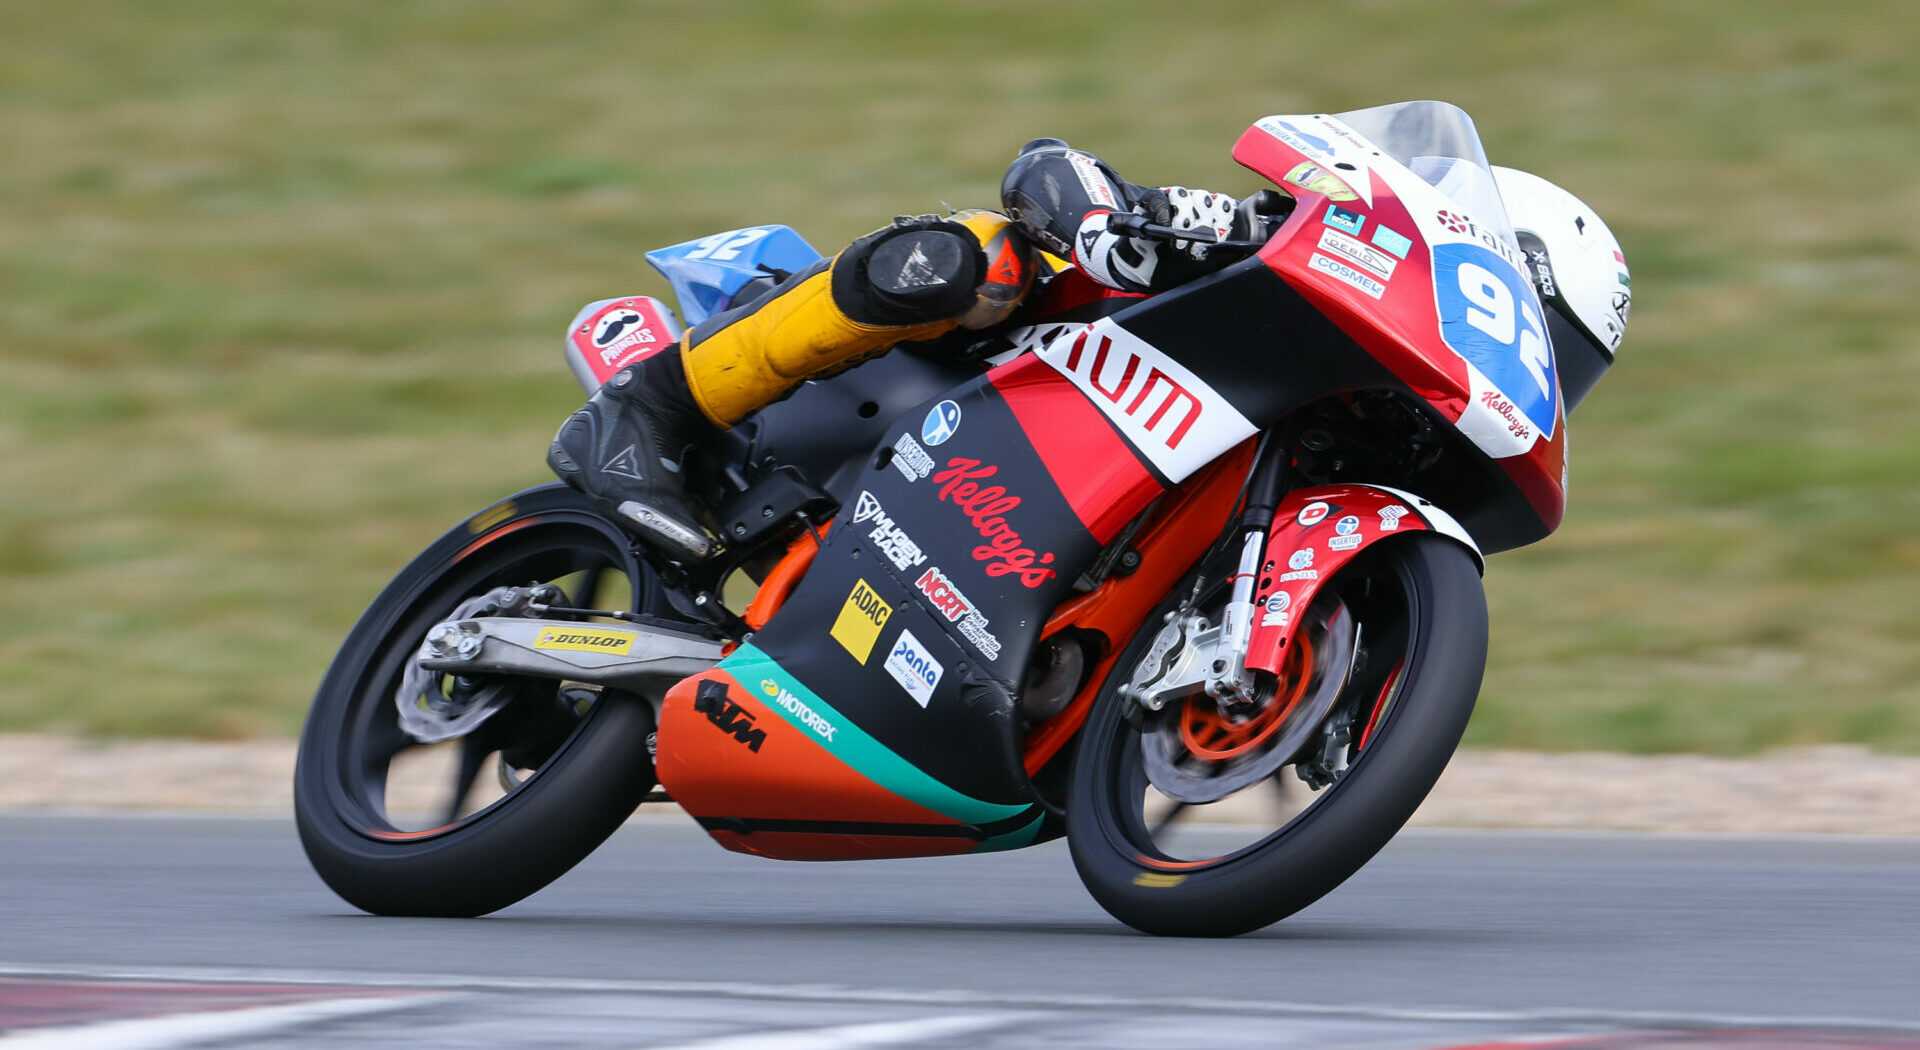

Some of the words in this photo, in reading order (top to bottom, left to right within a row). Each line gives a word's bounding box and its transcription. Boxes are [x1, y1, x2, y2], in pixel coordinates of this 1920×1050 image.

[600, 328, 656, 366] PRINGLES
[1457, 262, 1550, 402] 92
[1480, 391, 1530, 440] Kellogg's
[894, 432, 935, 478] INSERTUS
[872, 510, 928, 567] MUGEN
[932, 457, 1057, 588] Kellogg's
[868, 528, 912, 572] RACE
[851, 585, 887, 626] ADAC
[553, 634, 628, 648] DUNLOP
[776, 688, 838, 742] MOTOREX
